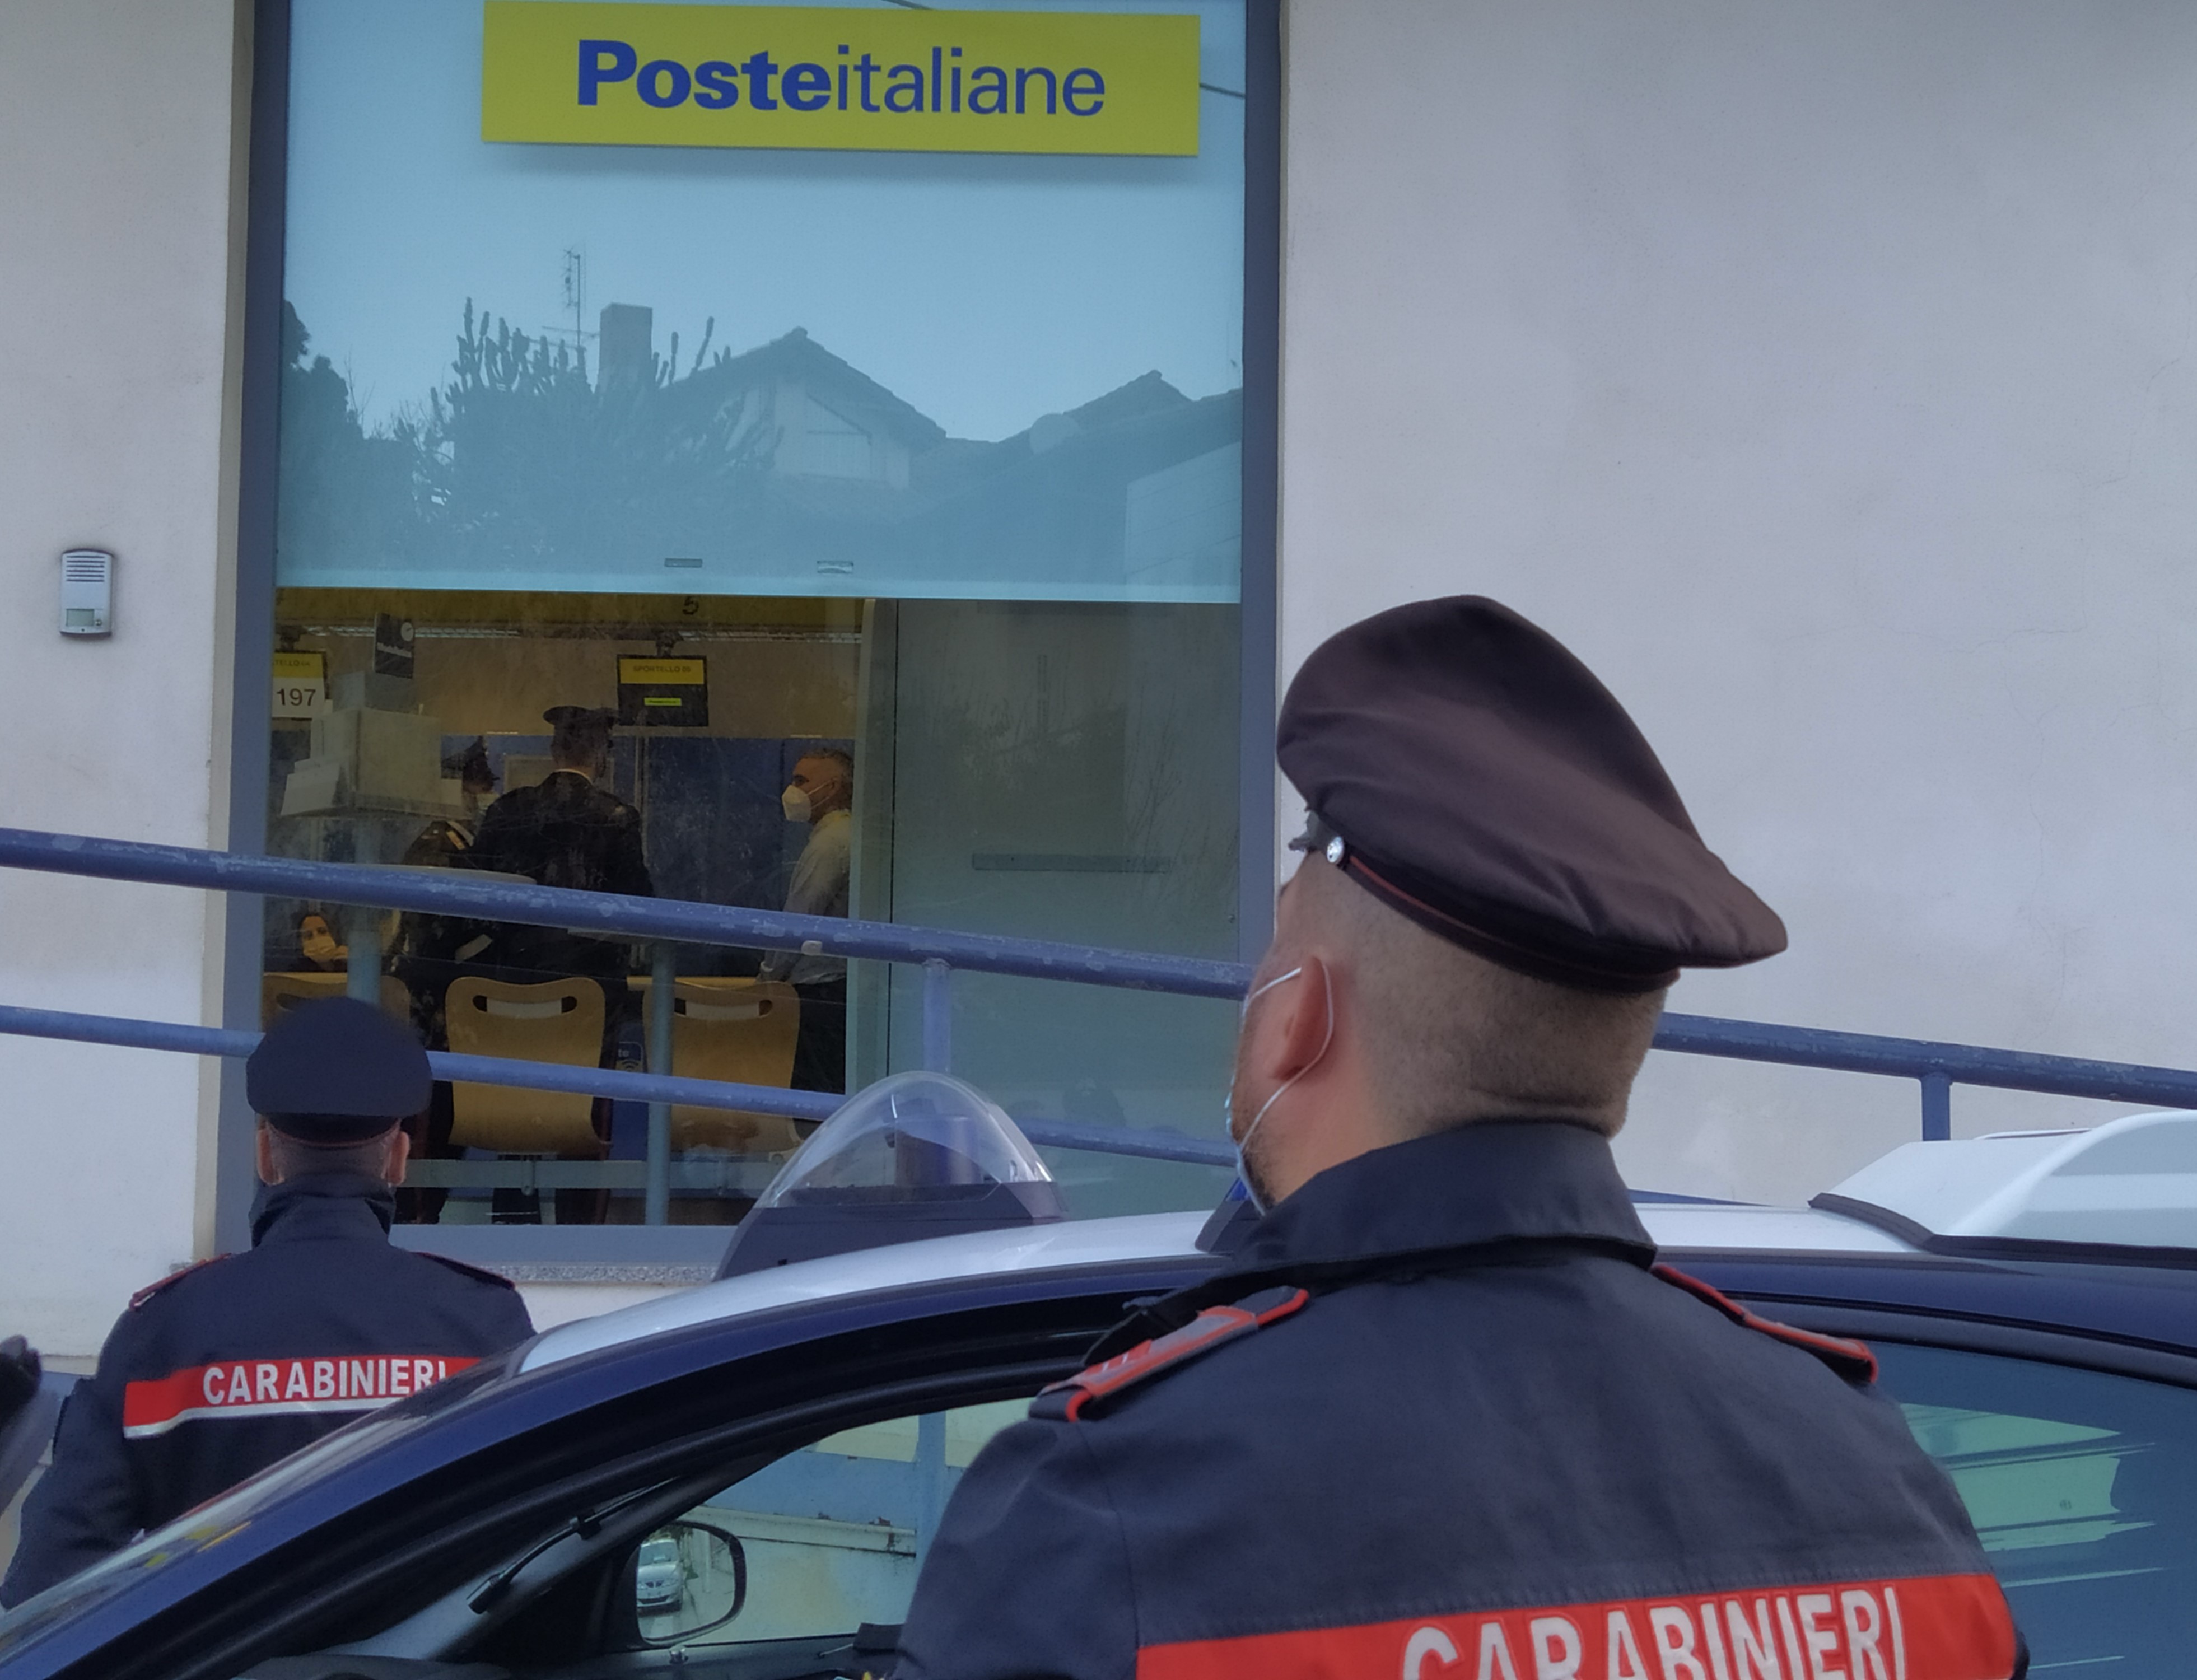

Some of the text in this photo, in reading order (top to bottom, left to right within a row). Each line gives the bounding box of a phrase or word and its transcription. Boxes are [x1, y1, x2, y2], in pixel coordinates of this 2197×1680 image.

[576, 39, 1106, 116] Posteitaliane
[682, 595, 699, 615] 5
[277, 688, 316, 706] 197
[617, 1049, 629, 1057] te
[1403, 1586, 1905, 1680] CARABINIERI
